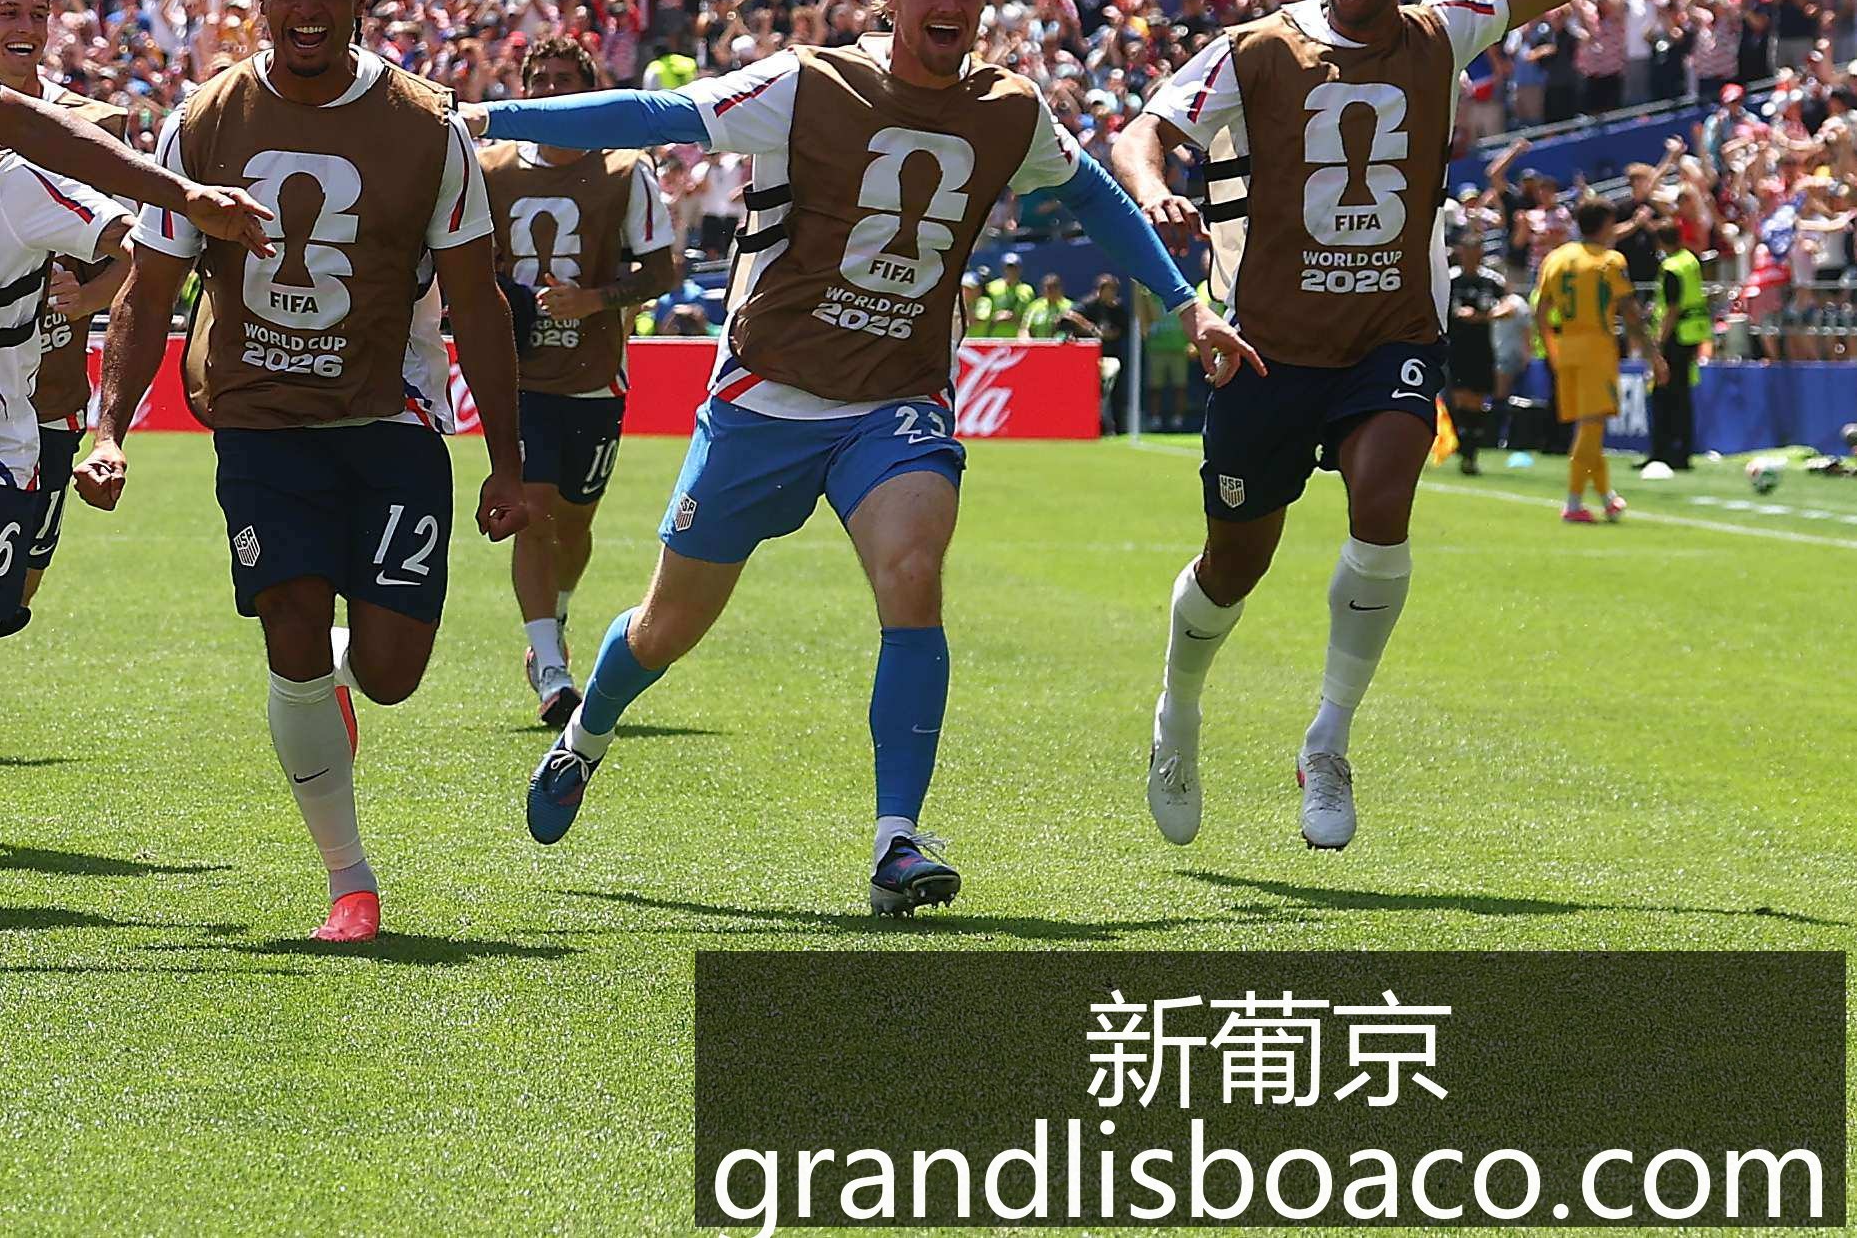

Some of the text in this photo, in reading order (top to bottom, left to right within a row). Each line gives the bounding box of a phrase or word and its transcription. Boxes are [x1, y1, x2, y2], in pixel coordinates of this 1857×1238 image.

[1334, 213, 1382, 232] FIFA
[868, 259, 916, 285] FIFA
[1302, 250, 1403, 267] WORLD CUP
[1300, 267, 1402, 294] 2026
[269, 291, 319, 314] FIFA
[825, 286, 892, 313] WORLD
[1560, 271, 1577, 320] 5
[811, 301, 913, 340] 2026
[243, 322, 348, 352] WORLD CUP
[530, 329, 581, 348] 026
[241, 341, 344, 378] 2026
[1400, 358, 1427, 387] 6
[584, 438, 618, 483] 10
[236, 528, 254, 549] USA
[372, 504, 439, 576] 12
